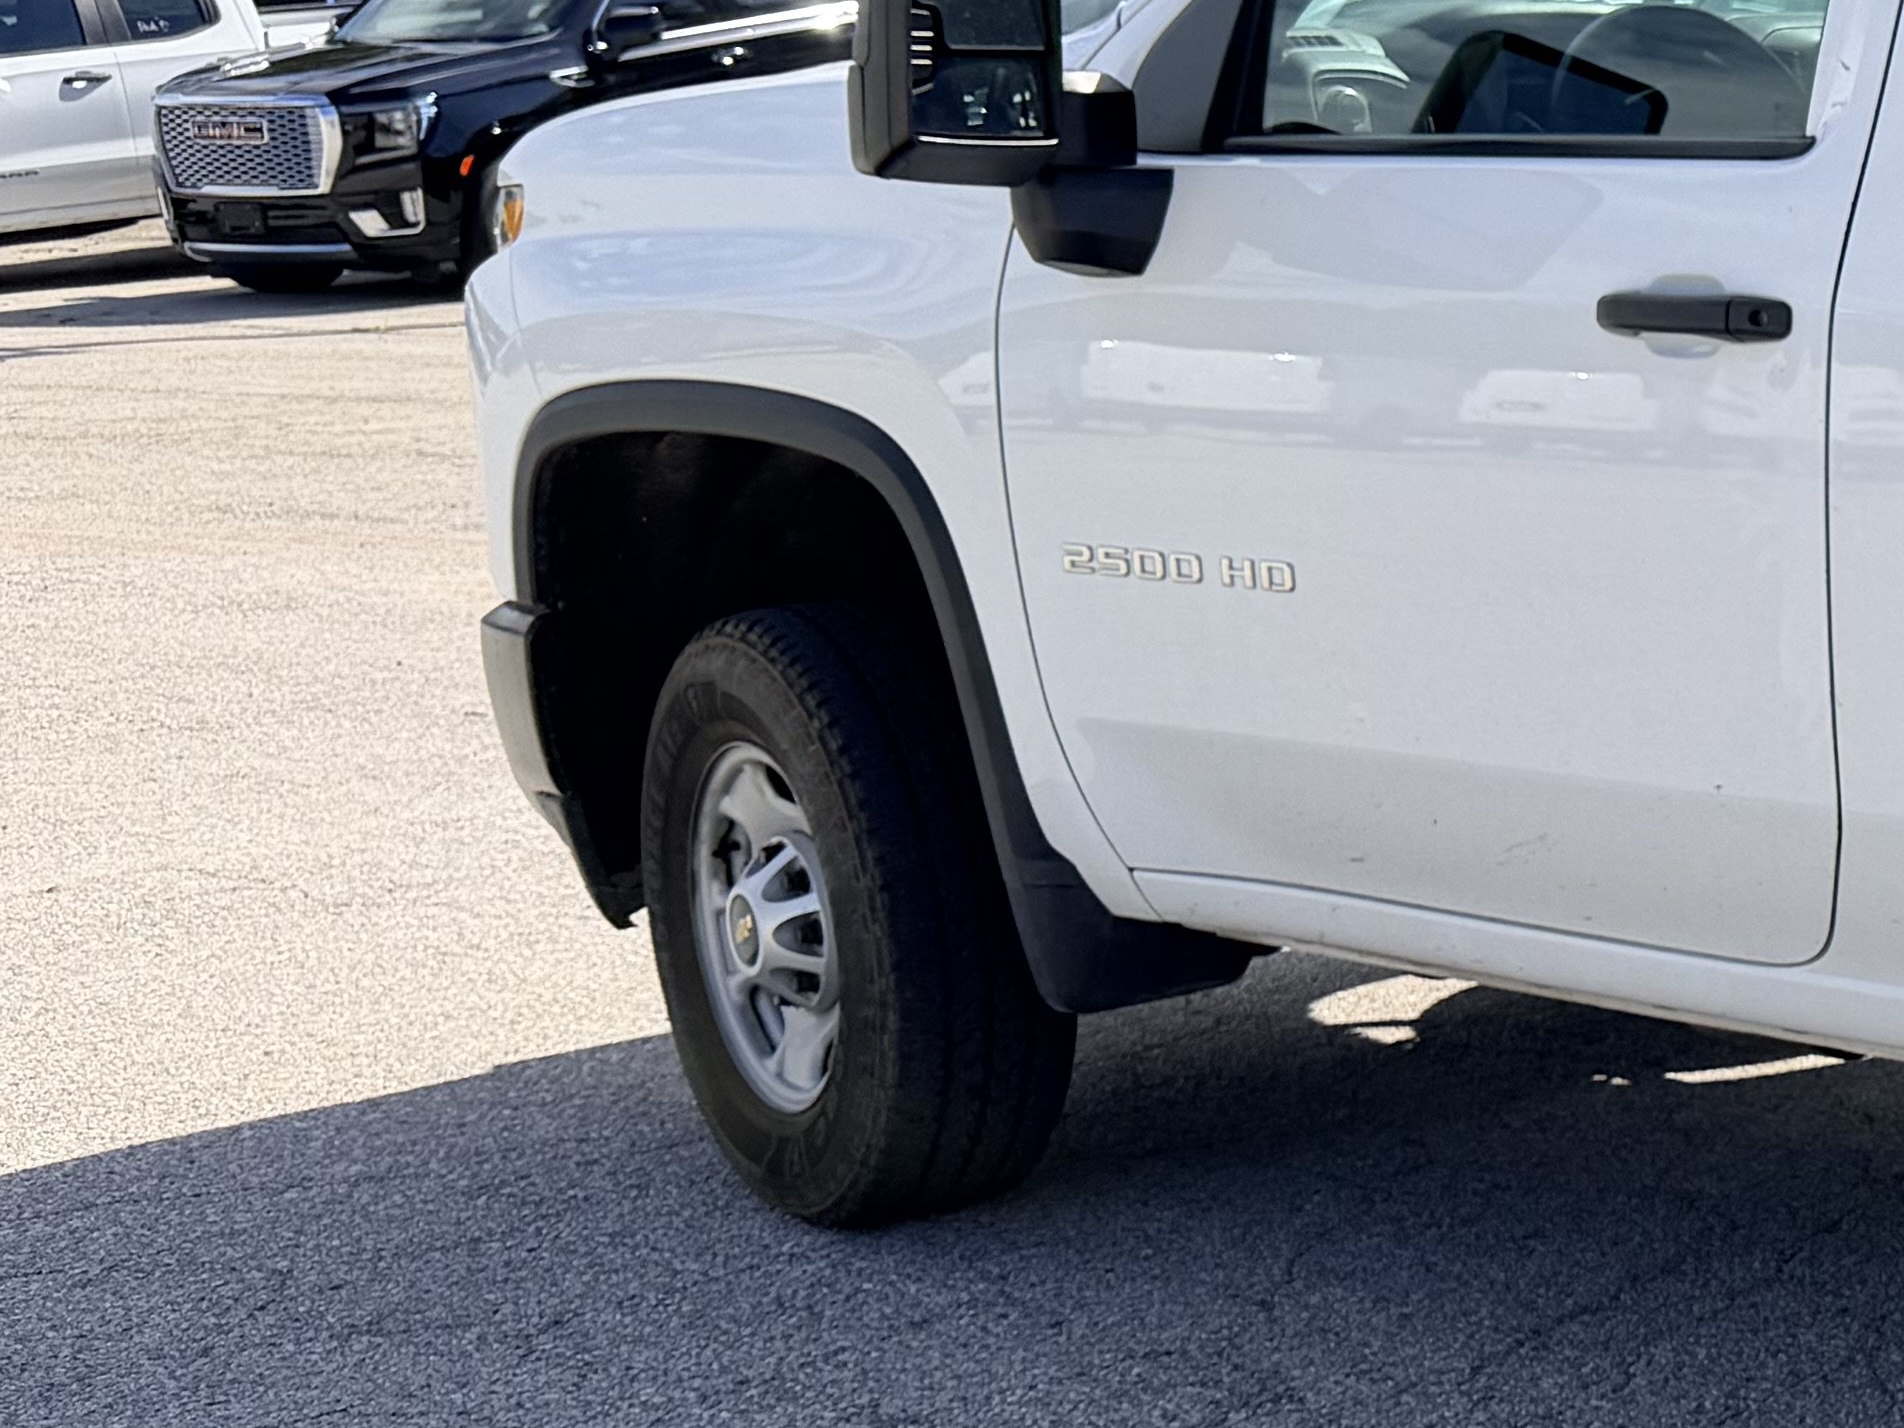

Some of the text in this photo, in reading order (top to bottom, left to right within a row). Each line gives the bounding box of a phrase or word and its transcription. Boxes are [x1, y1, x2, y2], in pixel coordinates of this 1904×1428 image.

[193, 120, 265, 142] GMC
[1061, 541, 1297, 593] 2500 HD
